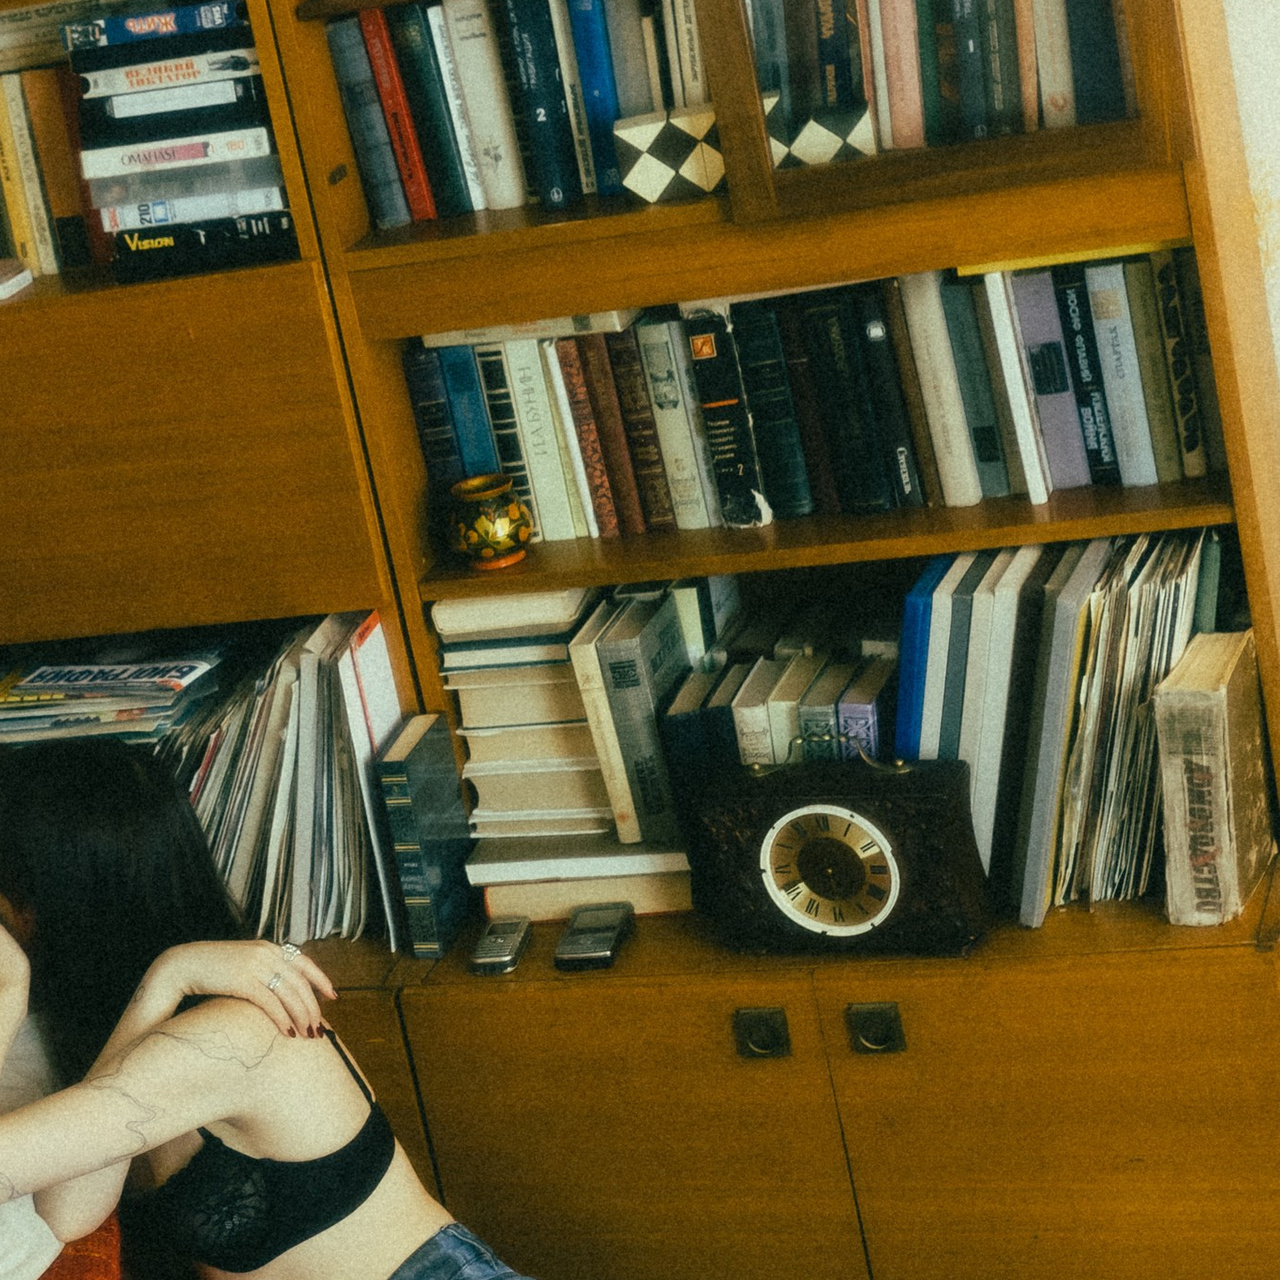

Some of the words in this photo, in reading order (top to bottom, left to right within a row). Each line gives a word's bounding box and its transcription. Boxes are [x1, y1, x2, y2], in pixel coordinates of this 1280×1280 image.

[123, 57, 195, 82] ВЕЛИКИЙ
[520, 32, 539, 89] ГРАВИТАЦИЯ
[684, 26, 699, 82] ЗАРУБЕЖНЫЙ
[535, 106, 547, 122] 2
[137, 202, 152, 225] 210
[123, 227, 175, 252] VISION
[1065, 288, 1081, 331] ИОСИФ
[1074, 333, 1092, 382] ФЛАВИЙ
[1108, 324, 1125, 379] СПАРТАК
[1080, 406, 1098, 450] ВОЙНА
[26, 663, 198, 687] БИОГРАФИЯ
[1177, 755, 1227, 915] ДОМОВОДСТВО
